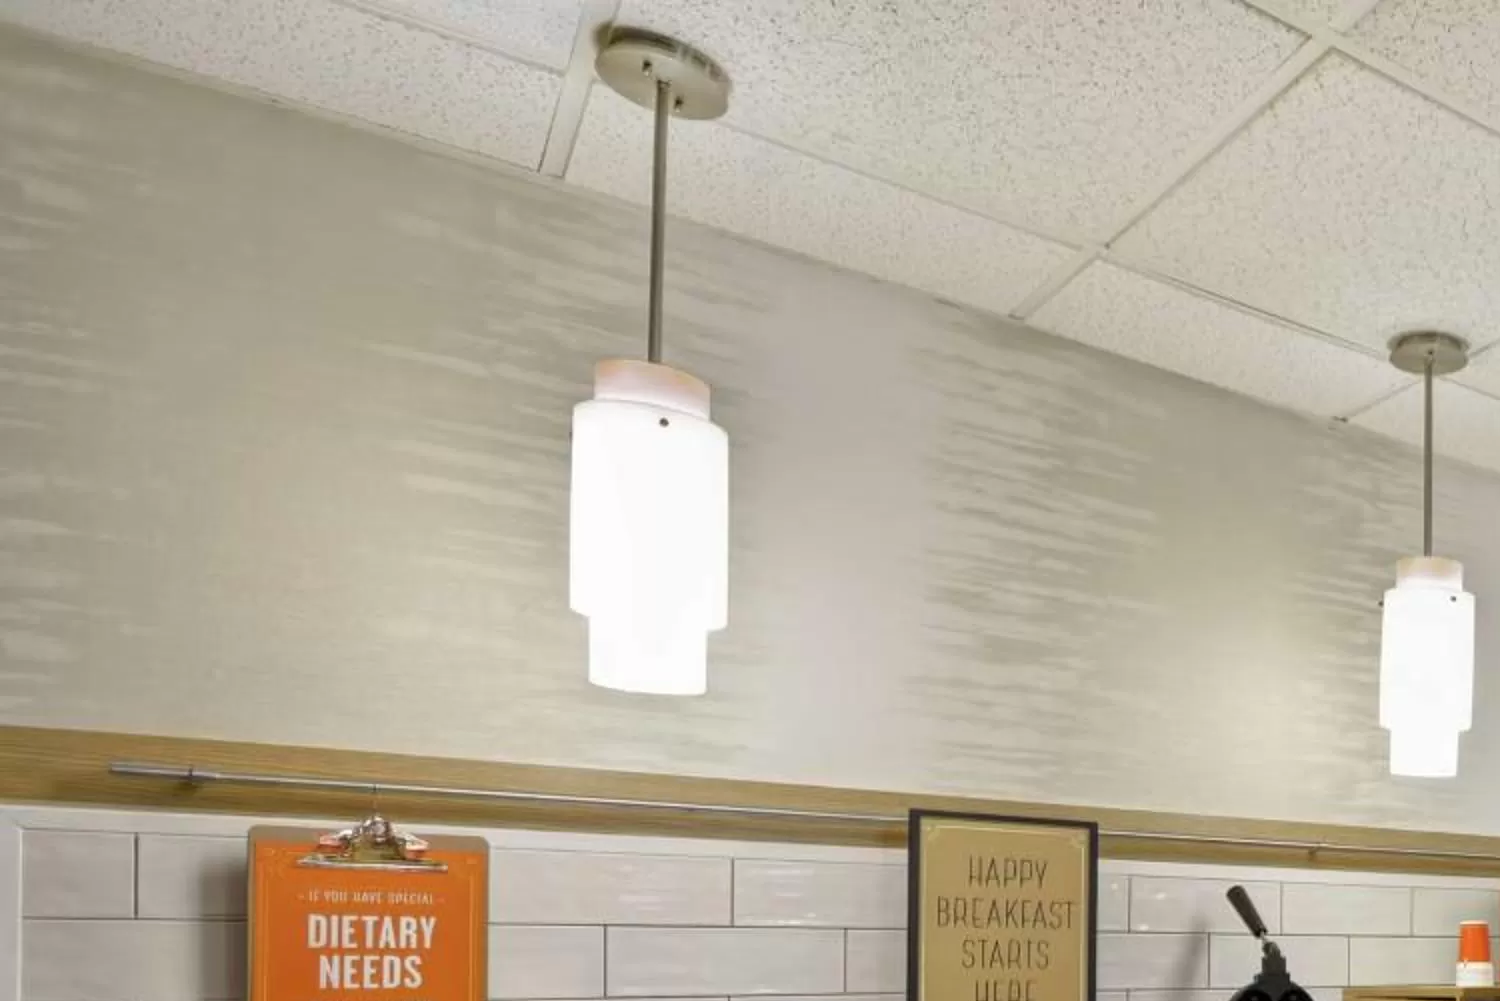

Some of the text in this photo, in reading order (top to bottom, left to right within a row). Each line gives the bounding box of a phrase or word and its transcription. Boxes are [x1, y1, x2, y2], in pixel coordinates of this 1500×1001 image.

[969, 854, 1048, 889] HAPPY
[388, 892, 433, 905] SPECIAL
[937, 895, 1075, 930] BREAKFAST
[307, 913, 437, 949] DIETARY
[319, 954, 424, 989] NEEDS
[961, 937, 1050, 971] STARTS
